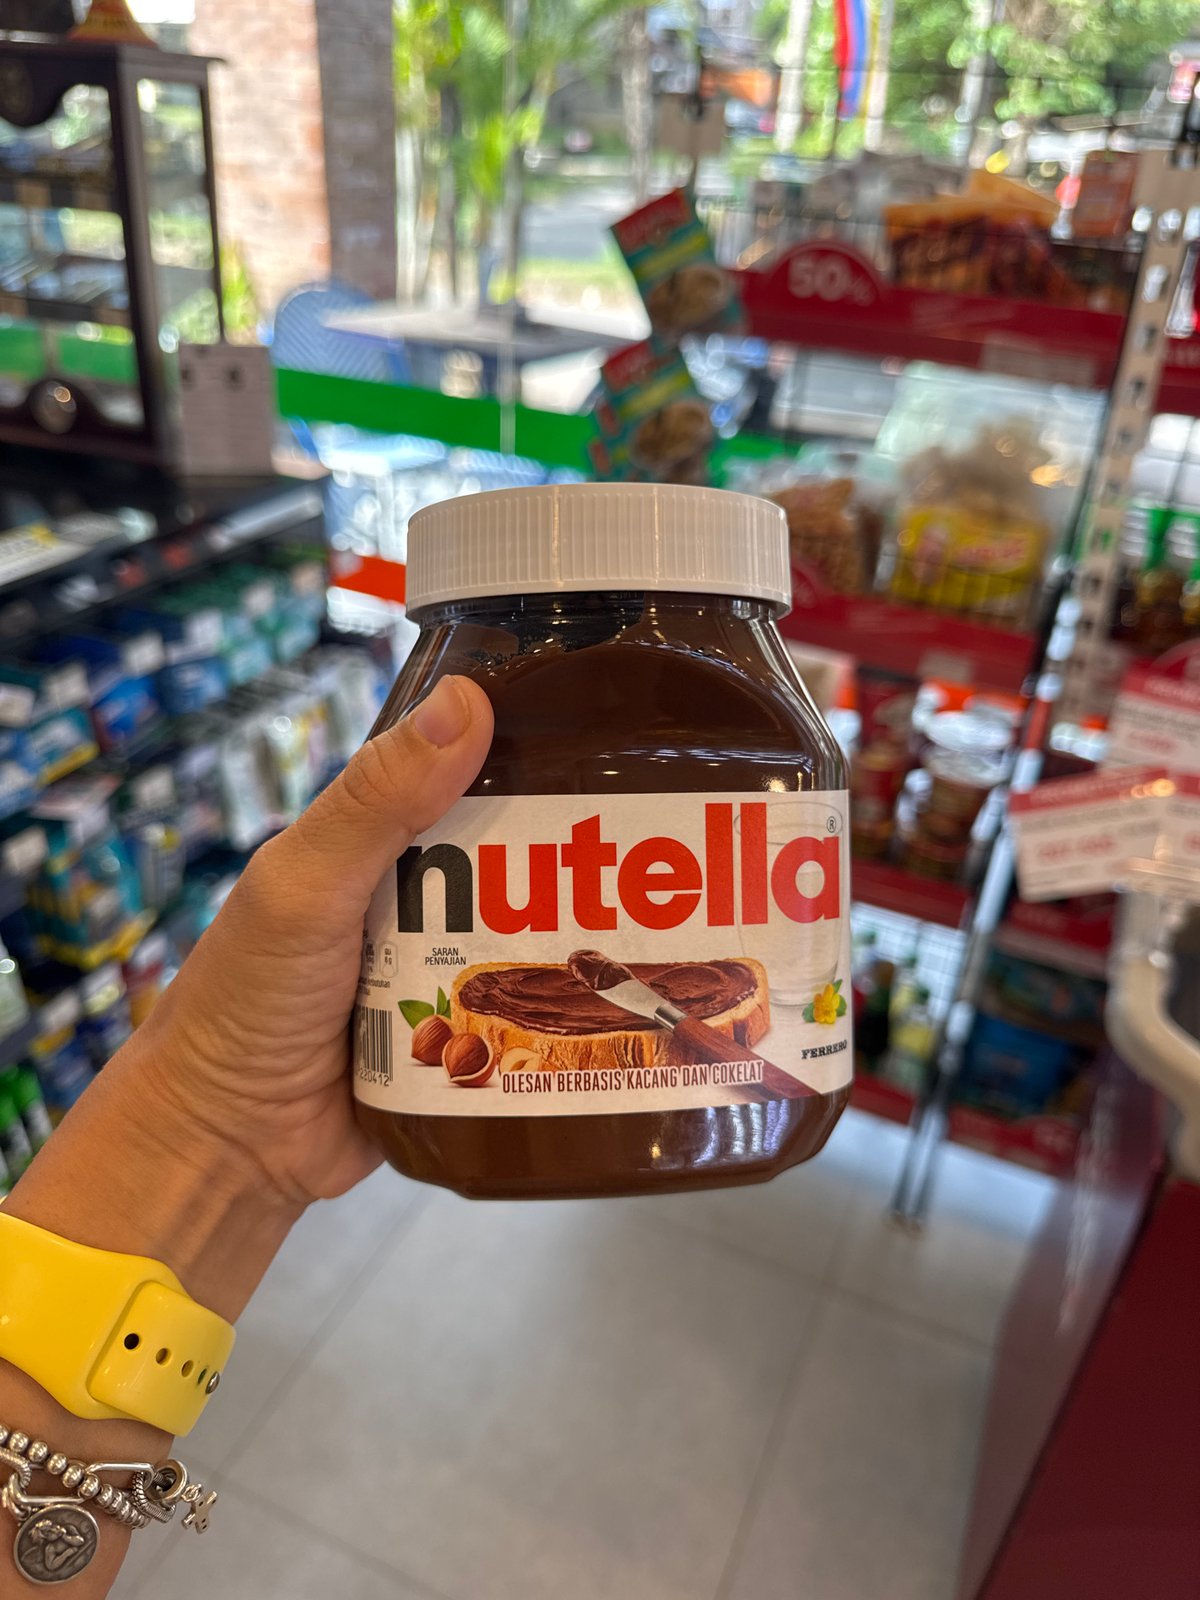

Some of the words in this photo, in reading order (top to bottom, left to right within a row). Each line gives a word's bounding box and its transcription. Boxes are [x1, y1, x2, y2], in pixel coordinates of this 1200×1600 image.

[396, 802, 840, 935] nutella
[424, 956, 467, 966] PENYAJIAN
[431, 946, 460, 957] SARAN
[800, 1039, 848, 1060] FERRERO
[502, 1072, 552, 1093] OLESAN
[556, 1070, 622, 1092] BERBASIS
[626, 1066, 678, 1090] KACANG
[682, 1065, 708, 1087] DAN
[711, 1060, 763, 1085] COKELAT
